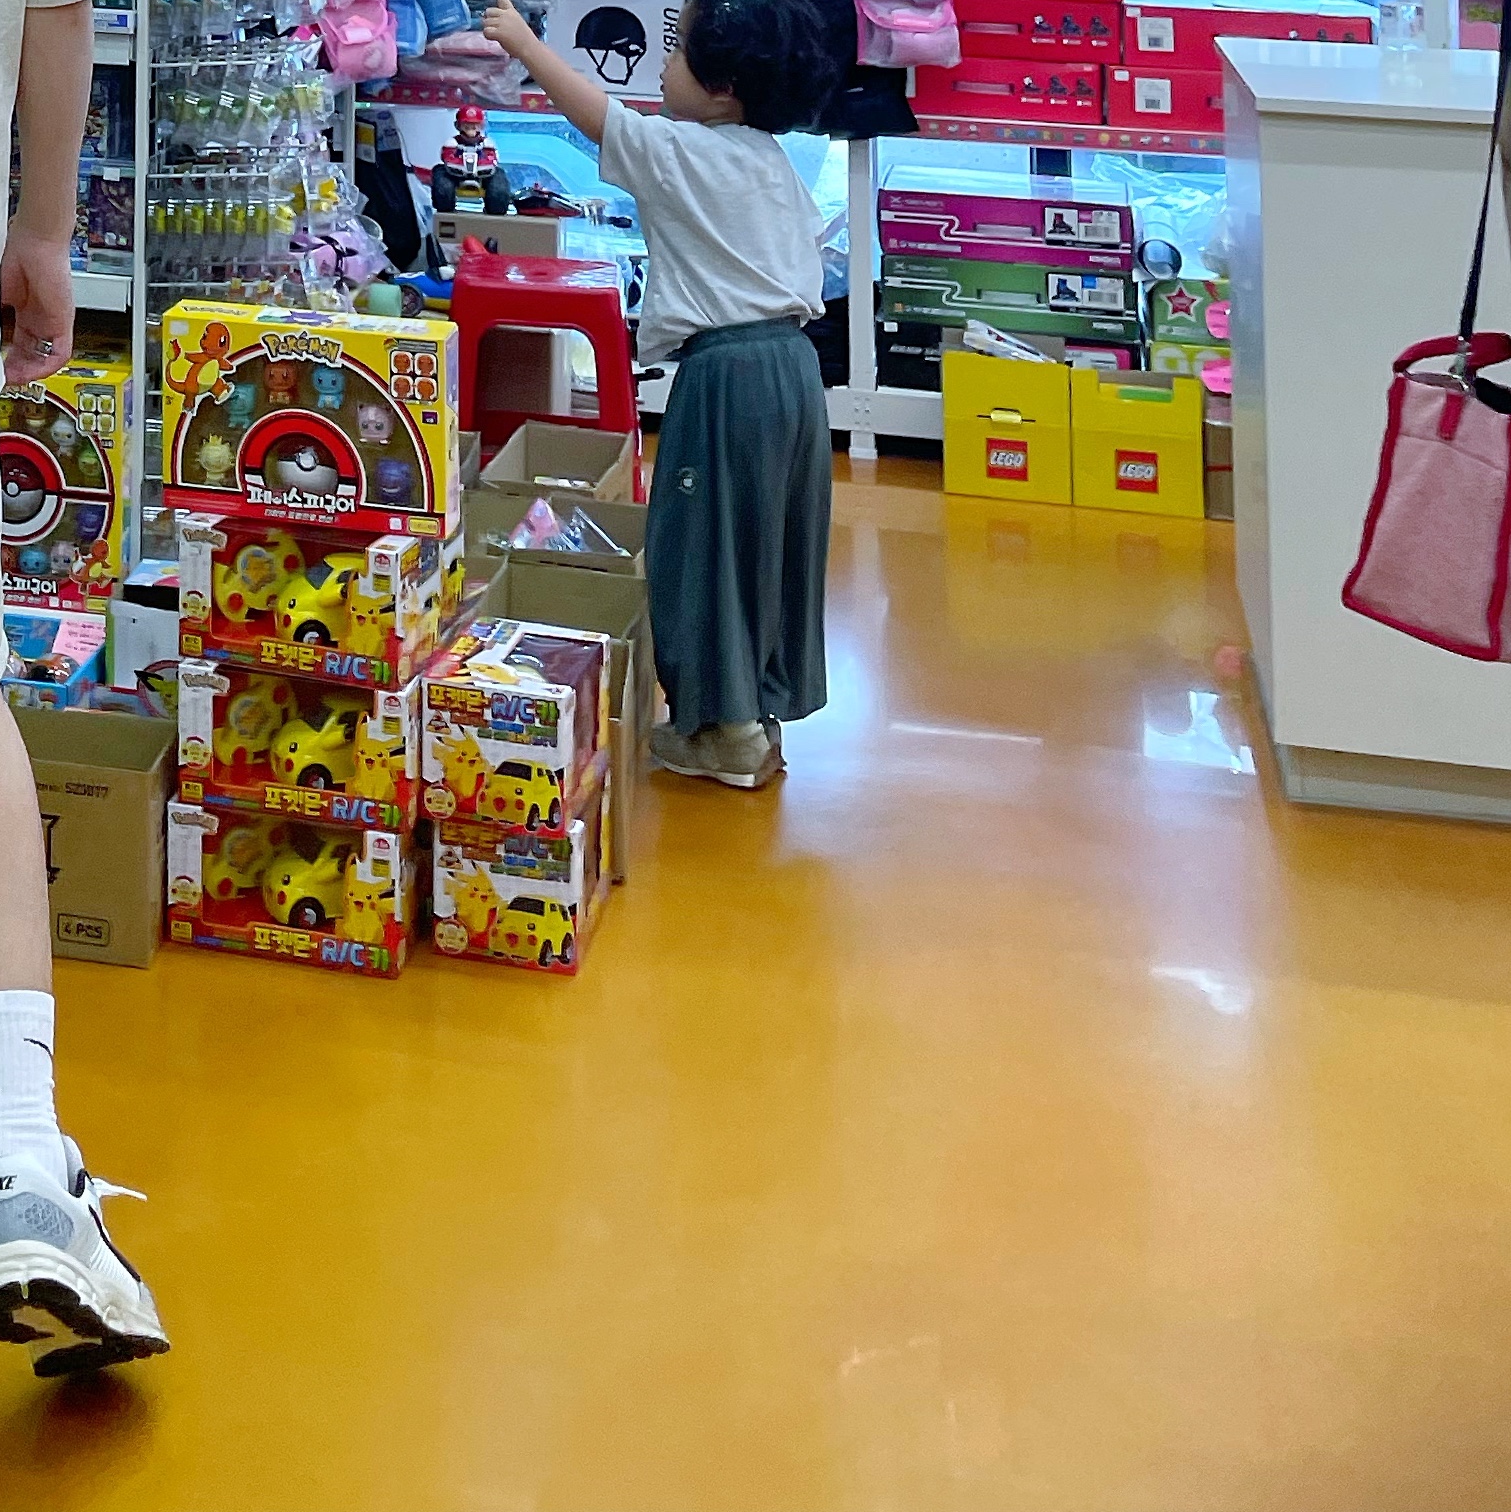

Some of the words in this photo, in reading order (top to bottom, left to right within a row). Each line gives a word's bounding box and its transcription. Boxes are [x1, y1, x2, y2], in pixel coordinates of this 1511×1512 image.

[989, 451, 1025, 468] LEGO
[1118, 462, 1155, 479] LEGO
[246, 486, 356, 513] 페이스피규어
[260, 641, 322, 671] 포켓몬
[264, 786, 328, 817] 포켓몬
[253, 926, 318, 958] 포켓몬
